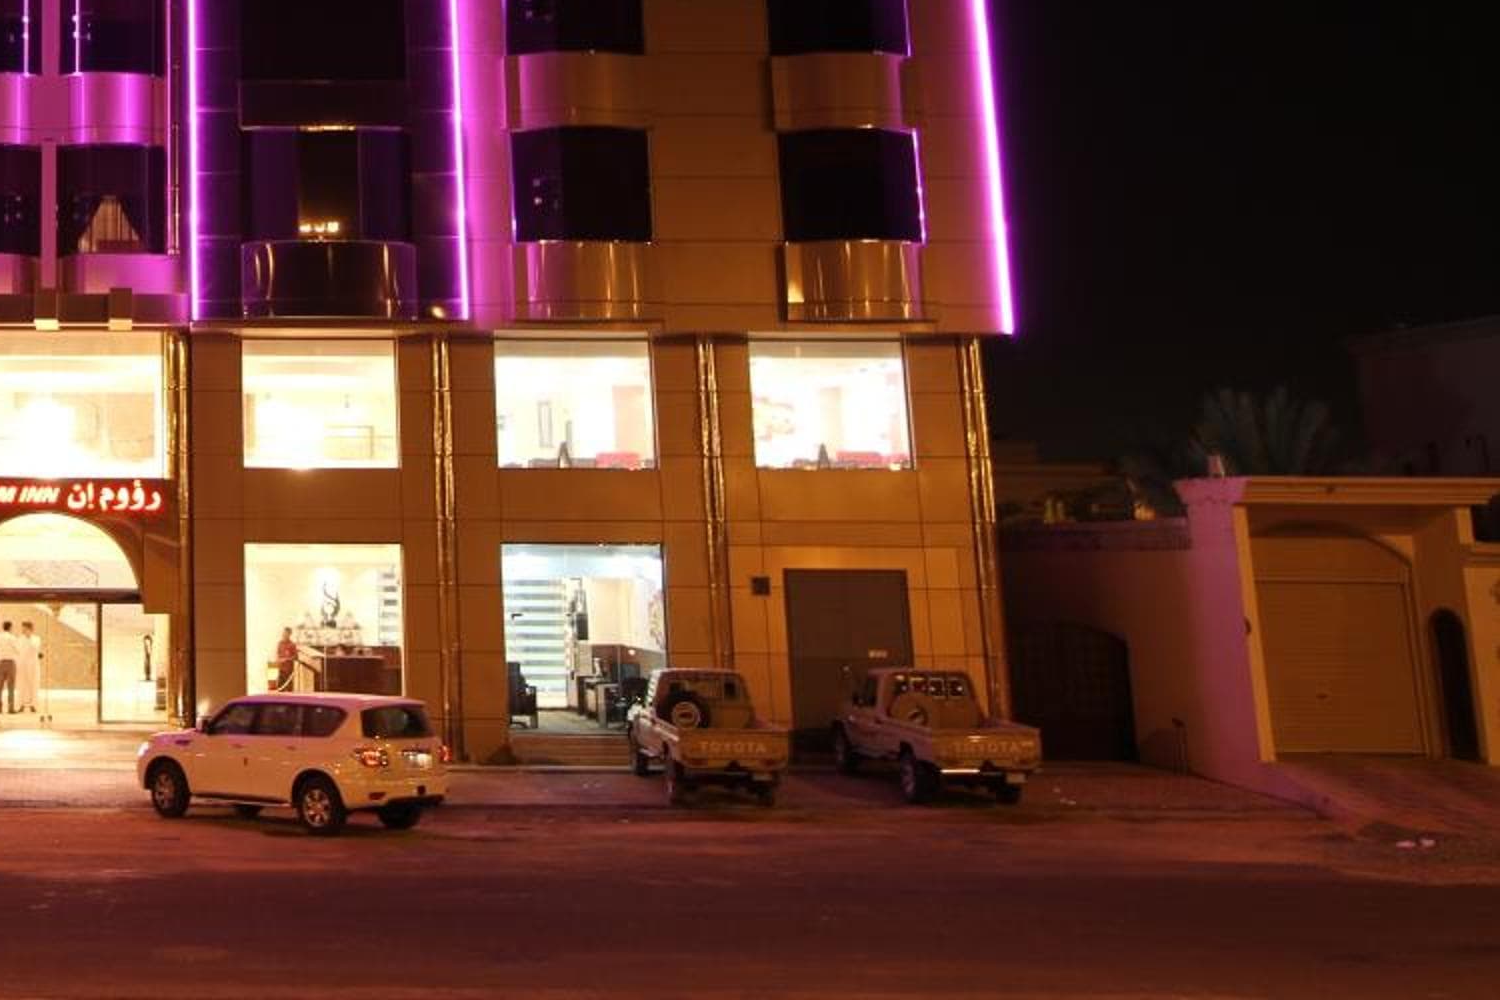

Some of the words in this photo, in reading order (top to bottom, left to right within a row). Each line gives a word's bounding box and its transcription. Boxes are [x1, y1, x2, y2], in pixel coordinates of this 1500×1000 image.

[18, 485, 60, 504] INN
[99, 479, 161, 511] رؤوم
[699, 740, 767, 754] TOYOTA
